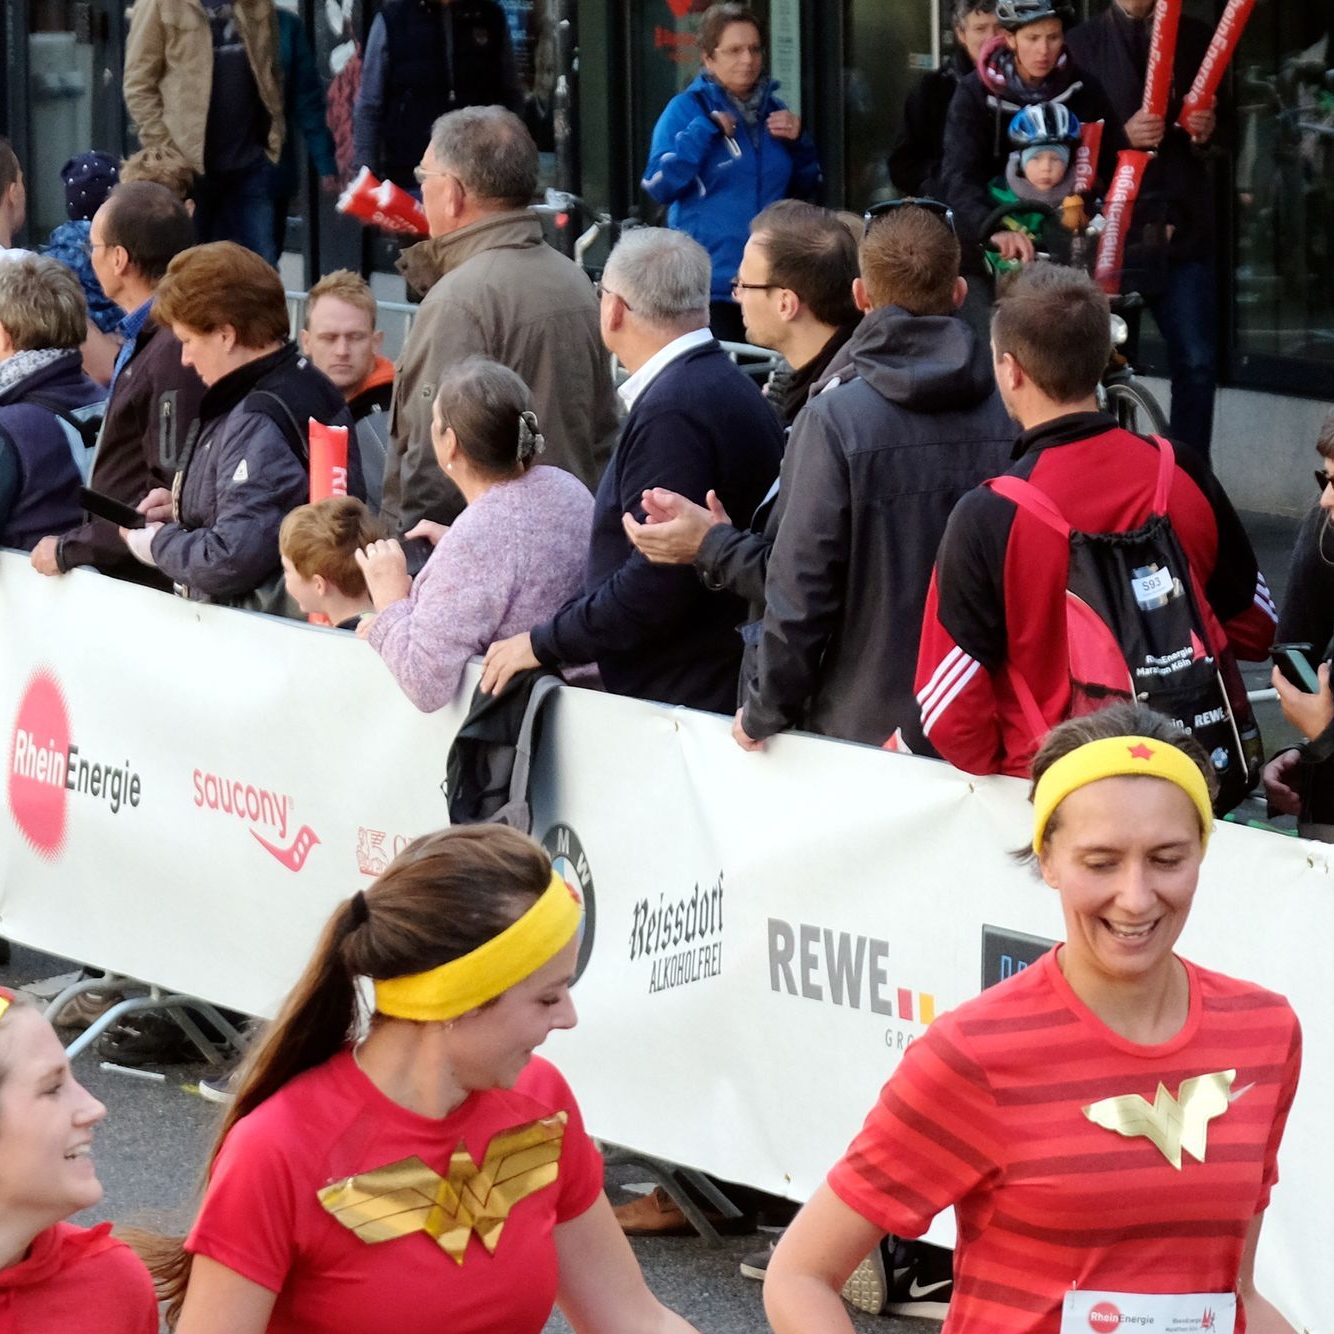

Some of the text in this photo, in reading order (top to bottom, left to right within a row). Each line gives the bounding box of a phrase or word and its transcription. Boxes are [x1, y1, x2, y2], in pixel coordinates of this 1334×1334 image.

[1141, 577, 1162, 592] S93
[1171, 658, 1192, 672] Köln
[12, 728, 142, 814] RheinEnergie
[192, 768, 288, 840] saucony
[628, 868, 725, 962] Reissdorf
[648, 941, 723, 994] ALKOHOLFREI
[767, 917, 893, 1017] REWE
[1090, 1311, 1155, 1326] RheinEnergie
